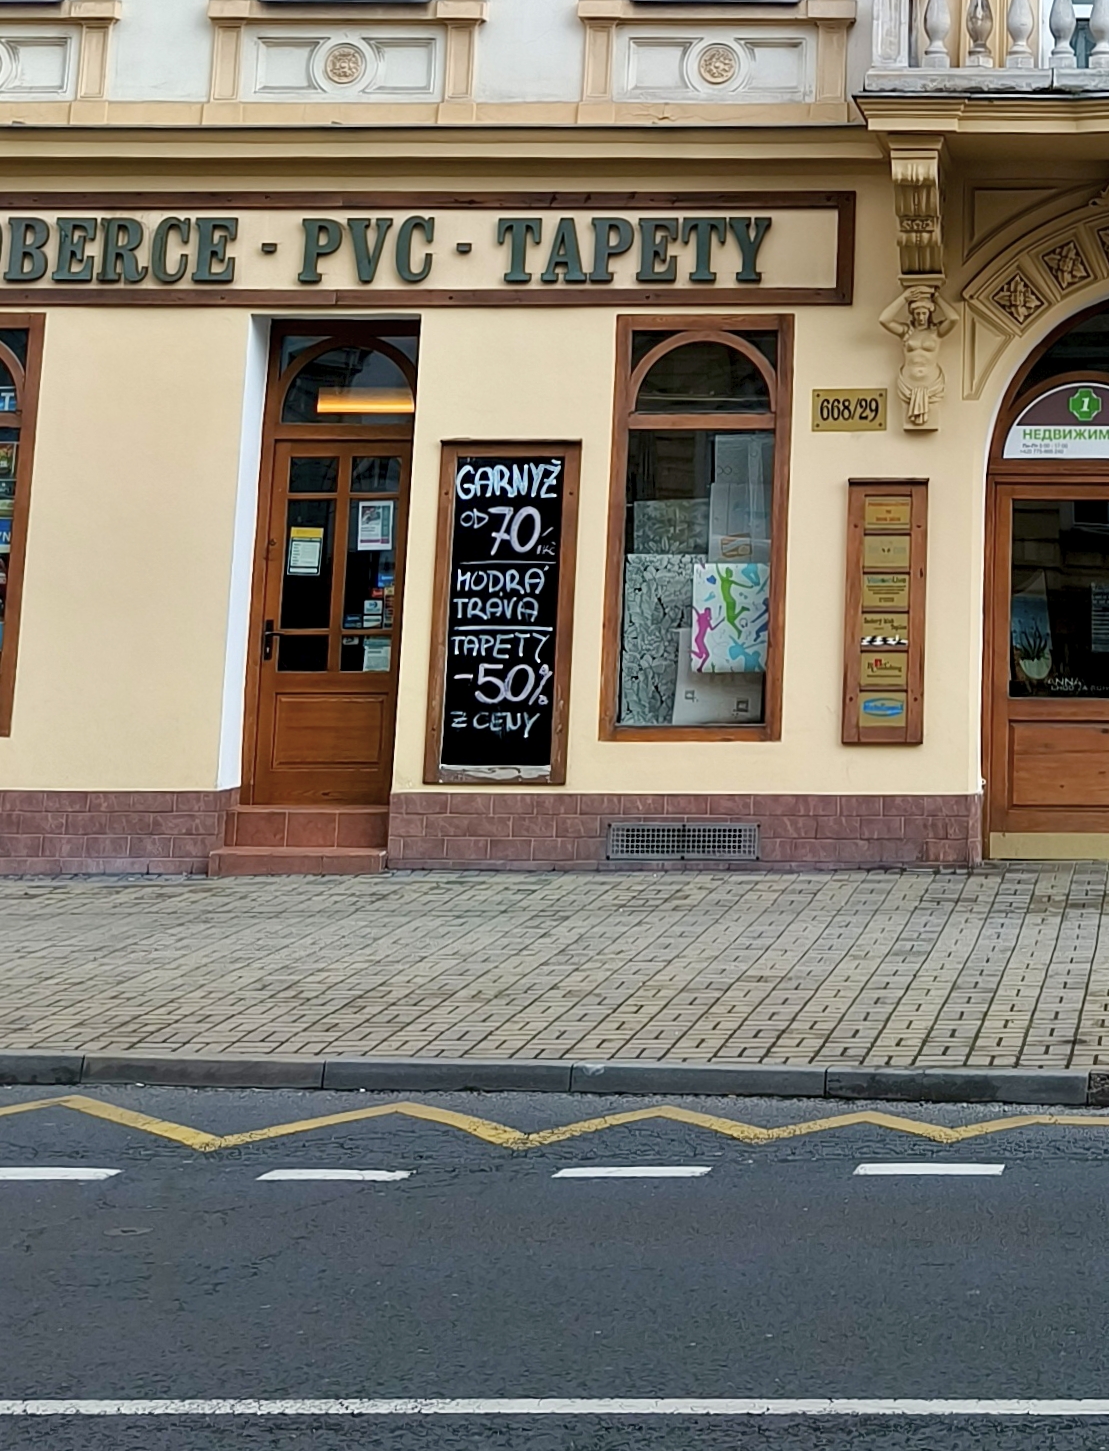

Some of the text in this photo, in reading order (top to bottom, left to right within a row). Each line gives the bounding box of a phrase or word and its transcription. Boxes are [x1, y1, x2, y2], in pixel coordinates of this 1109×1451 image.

[0, 216, 239, 284] BERCE
[298, 215, 435, 283] PVC
[497, 216, 772, 283] TAPETY
[819, 397, 880, 423] 668/29
[456, 459, 561, 500] GARNYŽ
[460, 508, 489, 529] OD
[456, 565, 550, 595] MODRÁ
[451, 632, 550, 663] TAPETY
[453, 663, 553, 706] -50%
[473, 712, 540, 738] CENY
